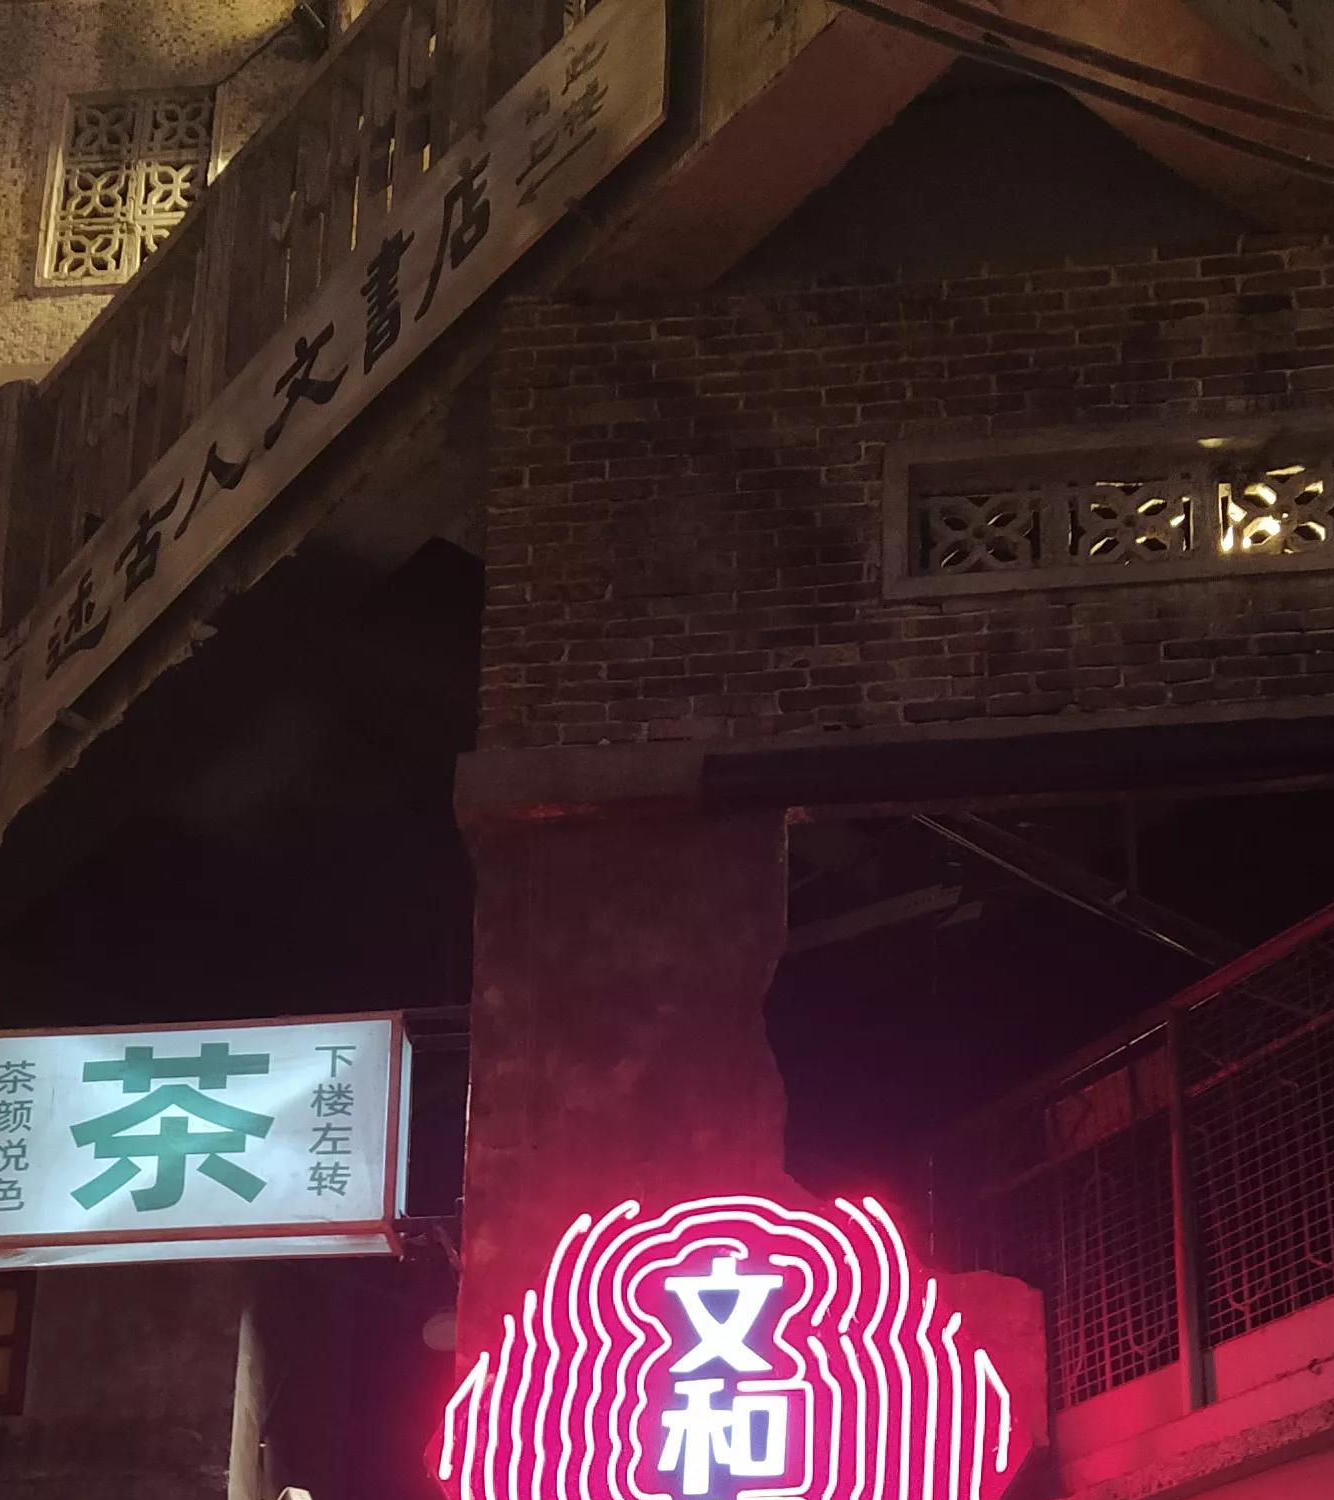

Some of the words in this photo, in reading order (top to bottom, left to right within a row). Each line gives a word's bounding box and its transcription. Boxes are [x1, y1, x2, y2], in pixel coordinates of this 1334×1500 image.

[70, 1042, 274, 1212] 茶
[308, 1045, 356, 1197] 下楼左转
